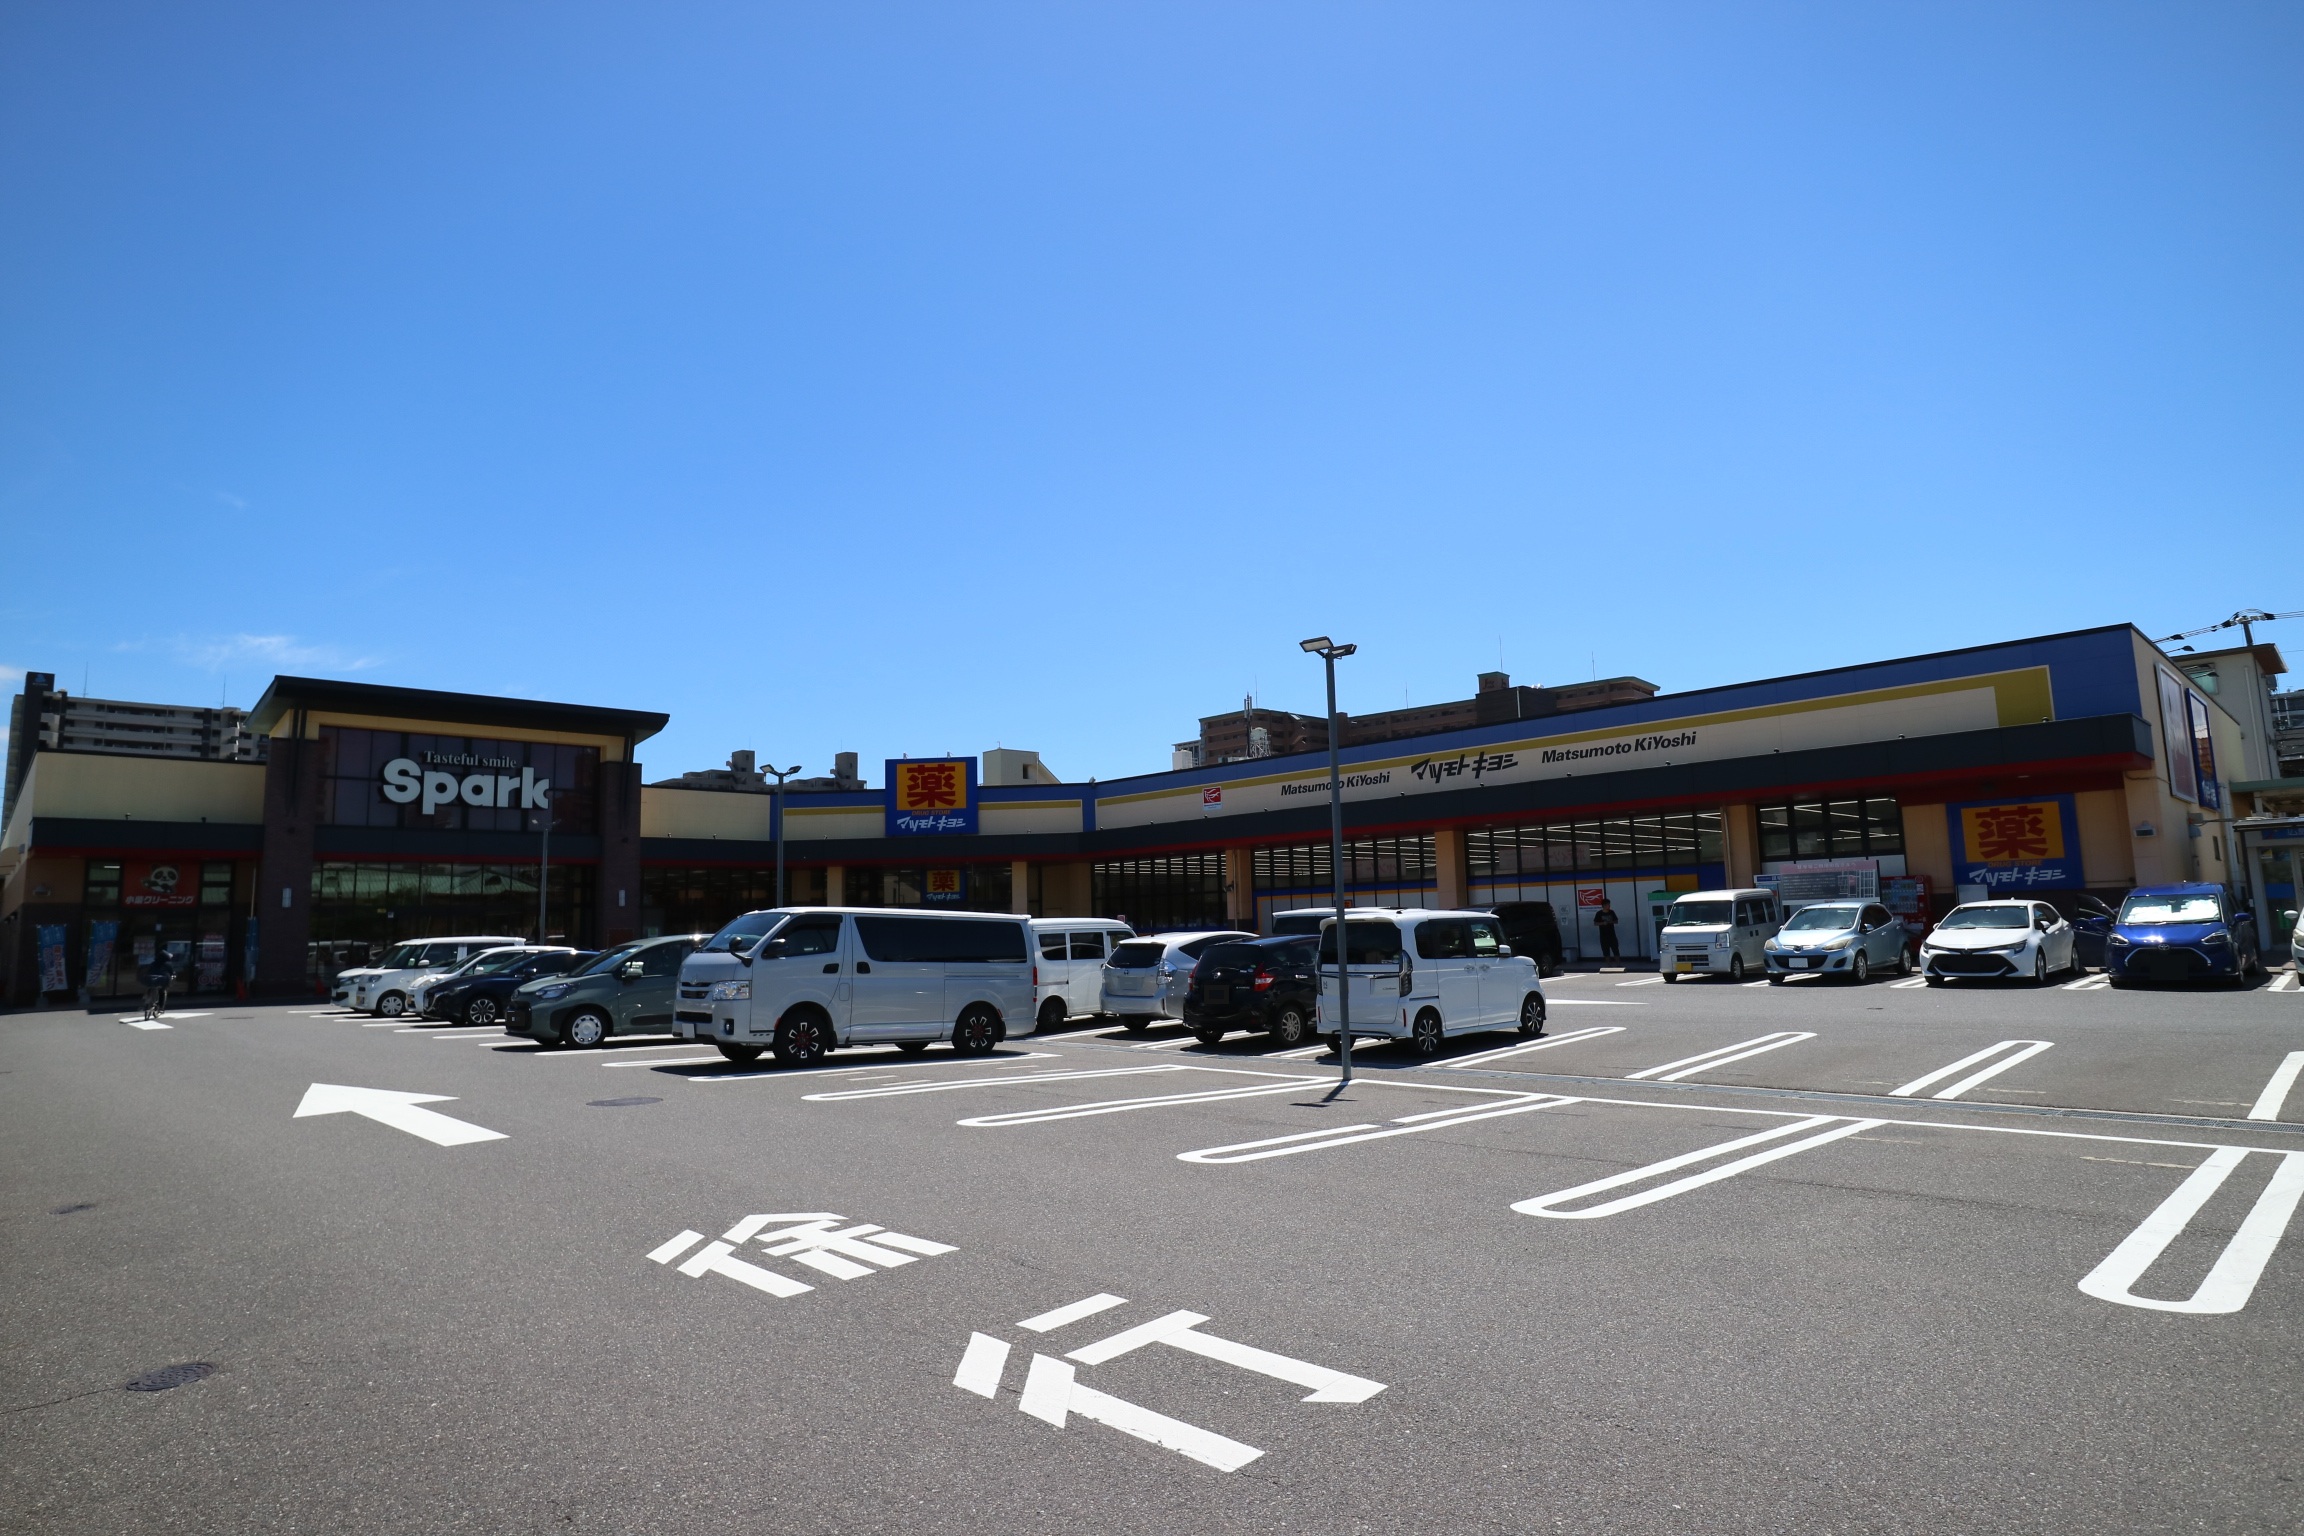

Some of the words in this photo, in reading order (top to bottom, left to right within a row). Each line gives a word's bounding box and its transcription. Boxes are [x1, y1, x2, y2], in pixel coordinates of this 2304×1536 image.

[424, 751, 479, 766] Tasteful
[482, 756, 517, 769] smile
[1541, 742, 1632, 764] Matsumoto
[1634, 731, 1697, 752] KiYoshi
[1281, 780, 1344, 796] Matsumoo
[1346, 771, 1391, 788] KiYoshi
[1410, 751, 1519, 784] マツモトキヨシ
[383, 758, 550, 815] Spark
[906, 763, 957, 808] 薬
[896, 815, 967, 832] マツモトキヨシ
[1975, 805, 2049, 859] 薬
[932, 871, 956, 892] 薬
[1969, 866, 2067, 887] マツモトキヨシ
[646, 1212, 1388, 1473] 徐行
